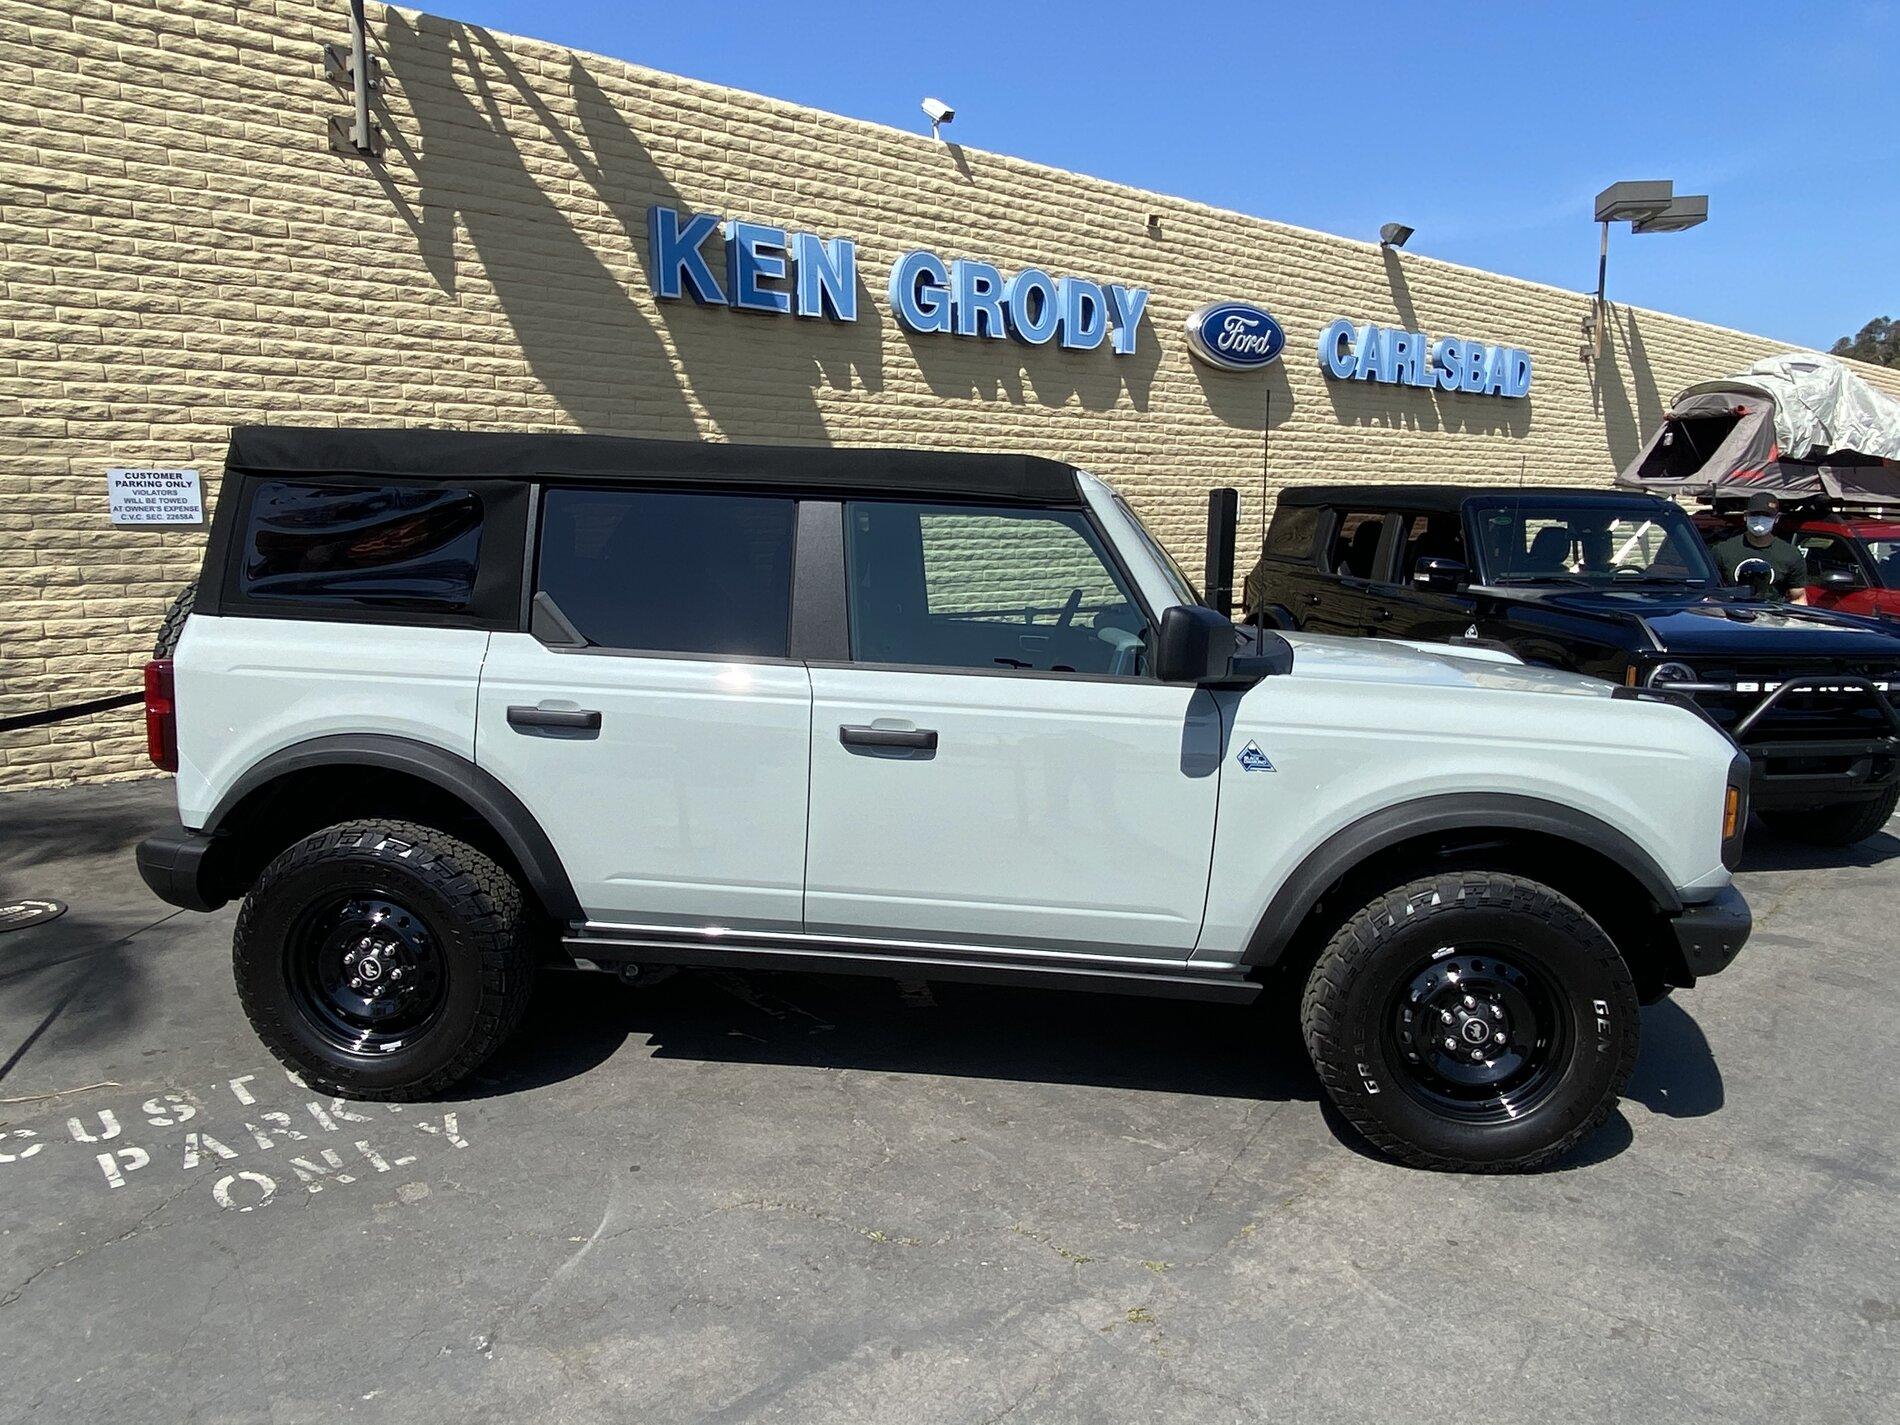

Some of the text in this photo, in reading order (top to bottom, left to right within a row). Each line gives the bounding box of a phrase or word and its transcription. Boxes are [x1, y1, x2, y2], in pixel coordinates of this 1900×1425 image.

[646, 204, 1151, 355] KEN GRODY
[1217, 314, 1272, 356] Ford
[1317, 317, 1533, 399] CARLSBAD
[115, 480, 163, 488] PARKING
[124, 472, 183, 480] CUSTOMER
